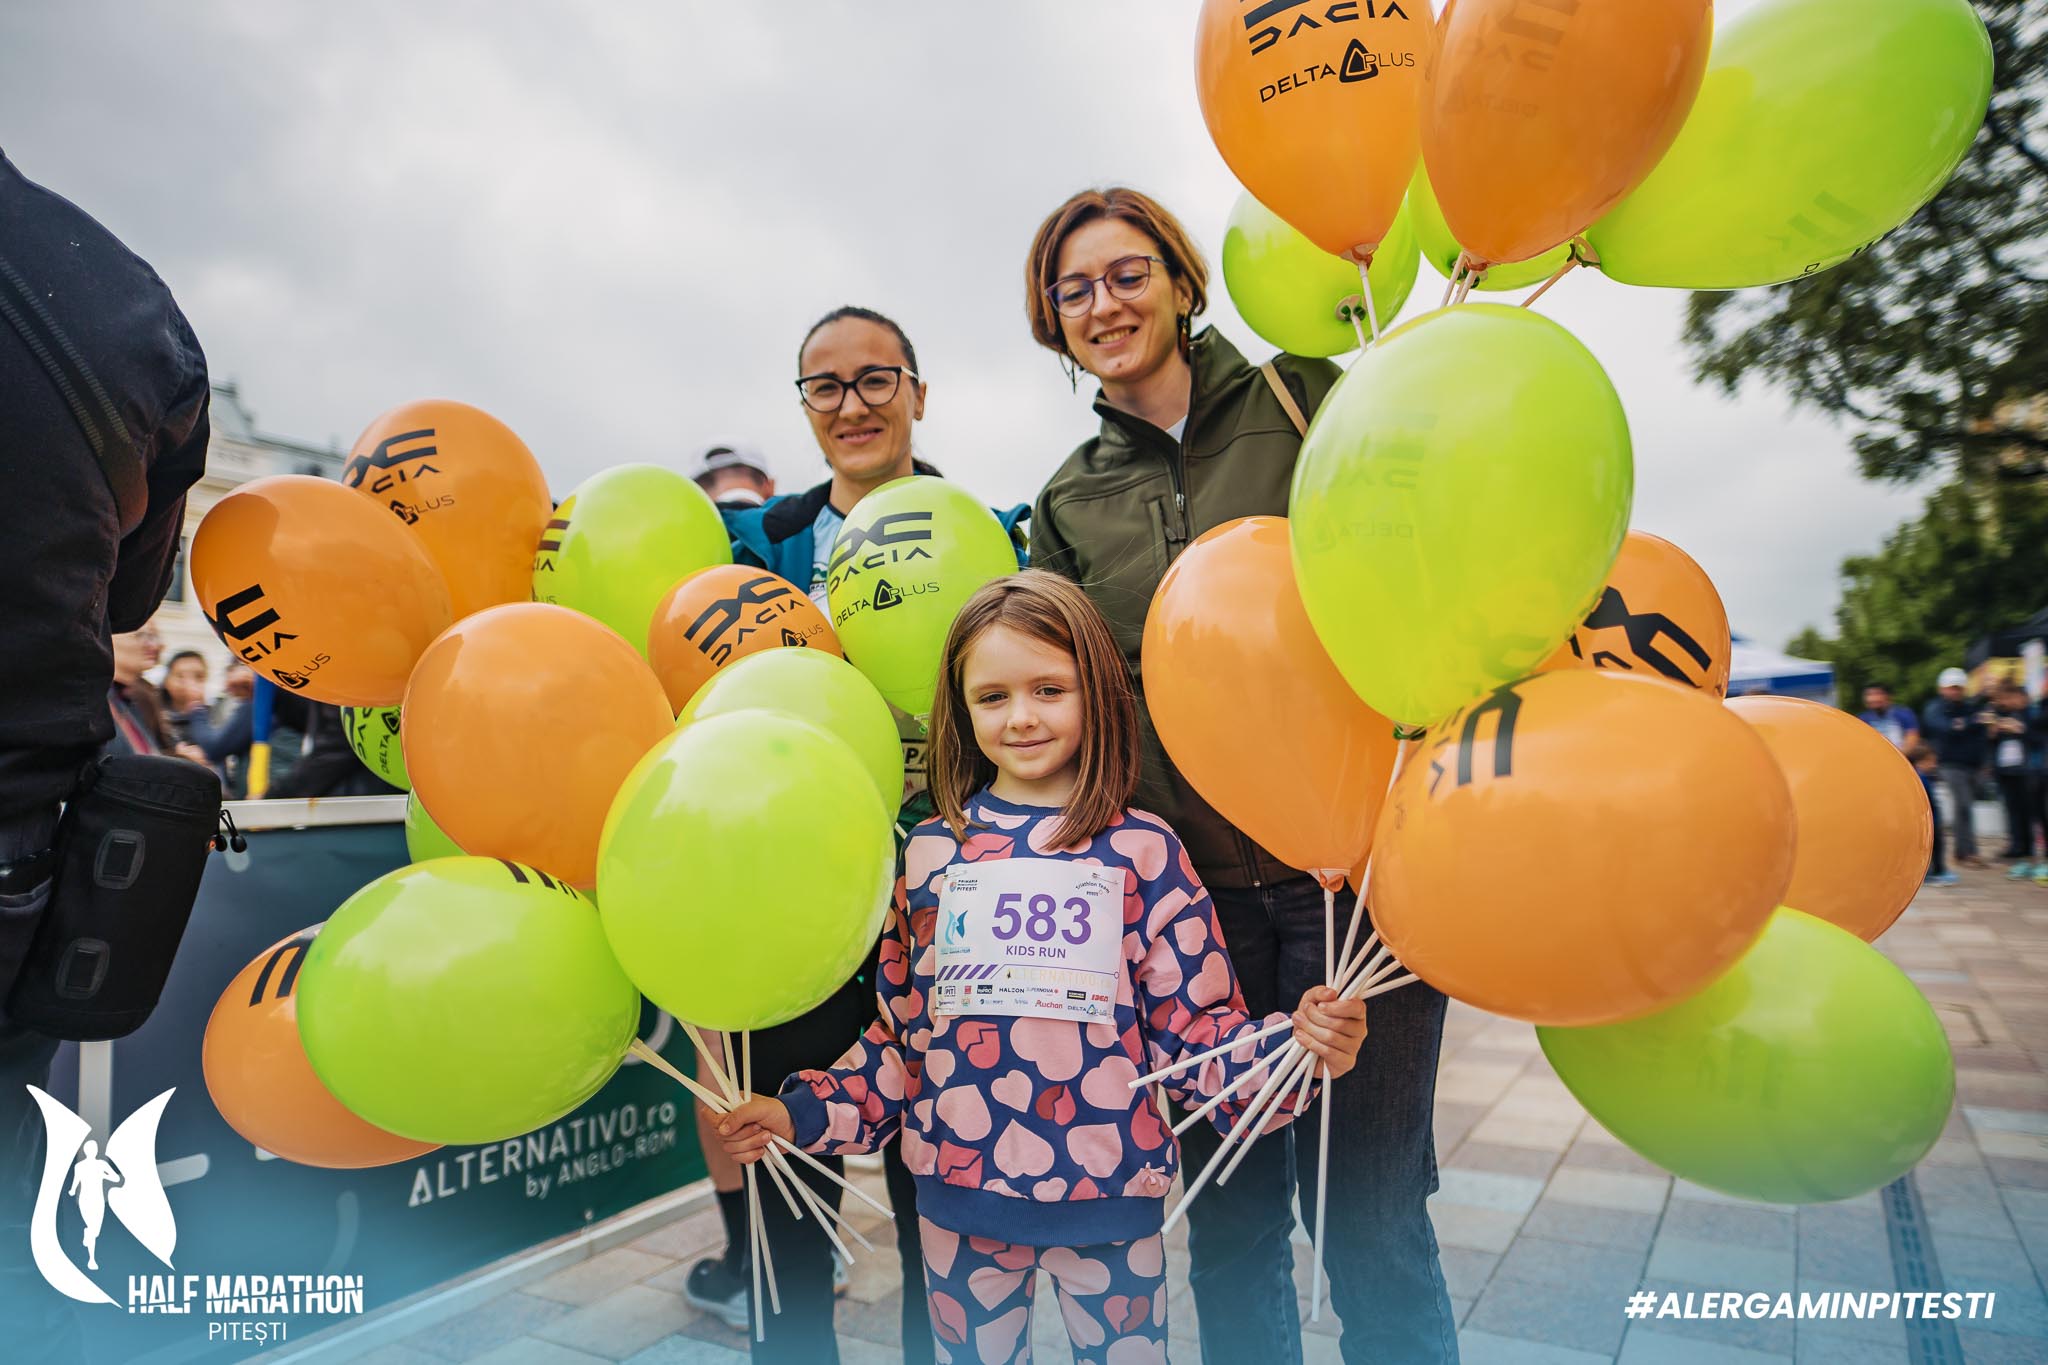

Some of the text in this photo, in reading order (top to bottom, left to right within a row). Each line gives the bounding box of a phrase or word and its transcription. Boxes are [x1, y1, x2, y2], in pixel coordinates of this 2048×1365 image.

[1259, 52, 1415, 103] DELTA PLUS
[371, 464, 440, 494] CIA
[403, 495, 455, 518] PLUS
[829, 546, 933, 595] DACIA
[836, 582, 940, 627] DELTA PLUS
[240, 632, 299, 663] CIA
[710, 599, 805, 667] DACIA
[794, 624, 824, 643] PLUS
[991, 893, 1092, 945] 583
[1006, 945, 1066, 959] KIDS RUN
[1035, 999, 1063, 1009] Auchan
[408, 1102, 676, 1208] ALTERNATIVO.ro
[525, 1127, 677, 1199] by ANGLO-ROM
